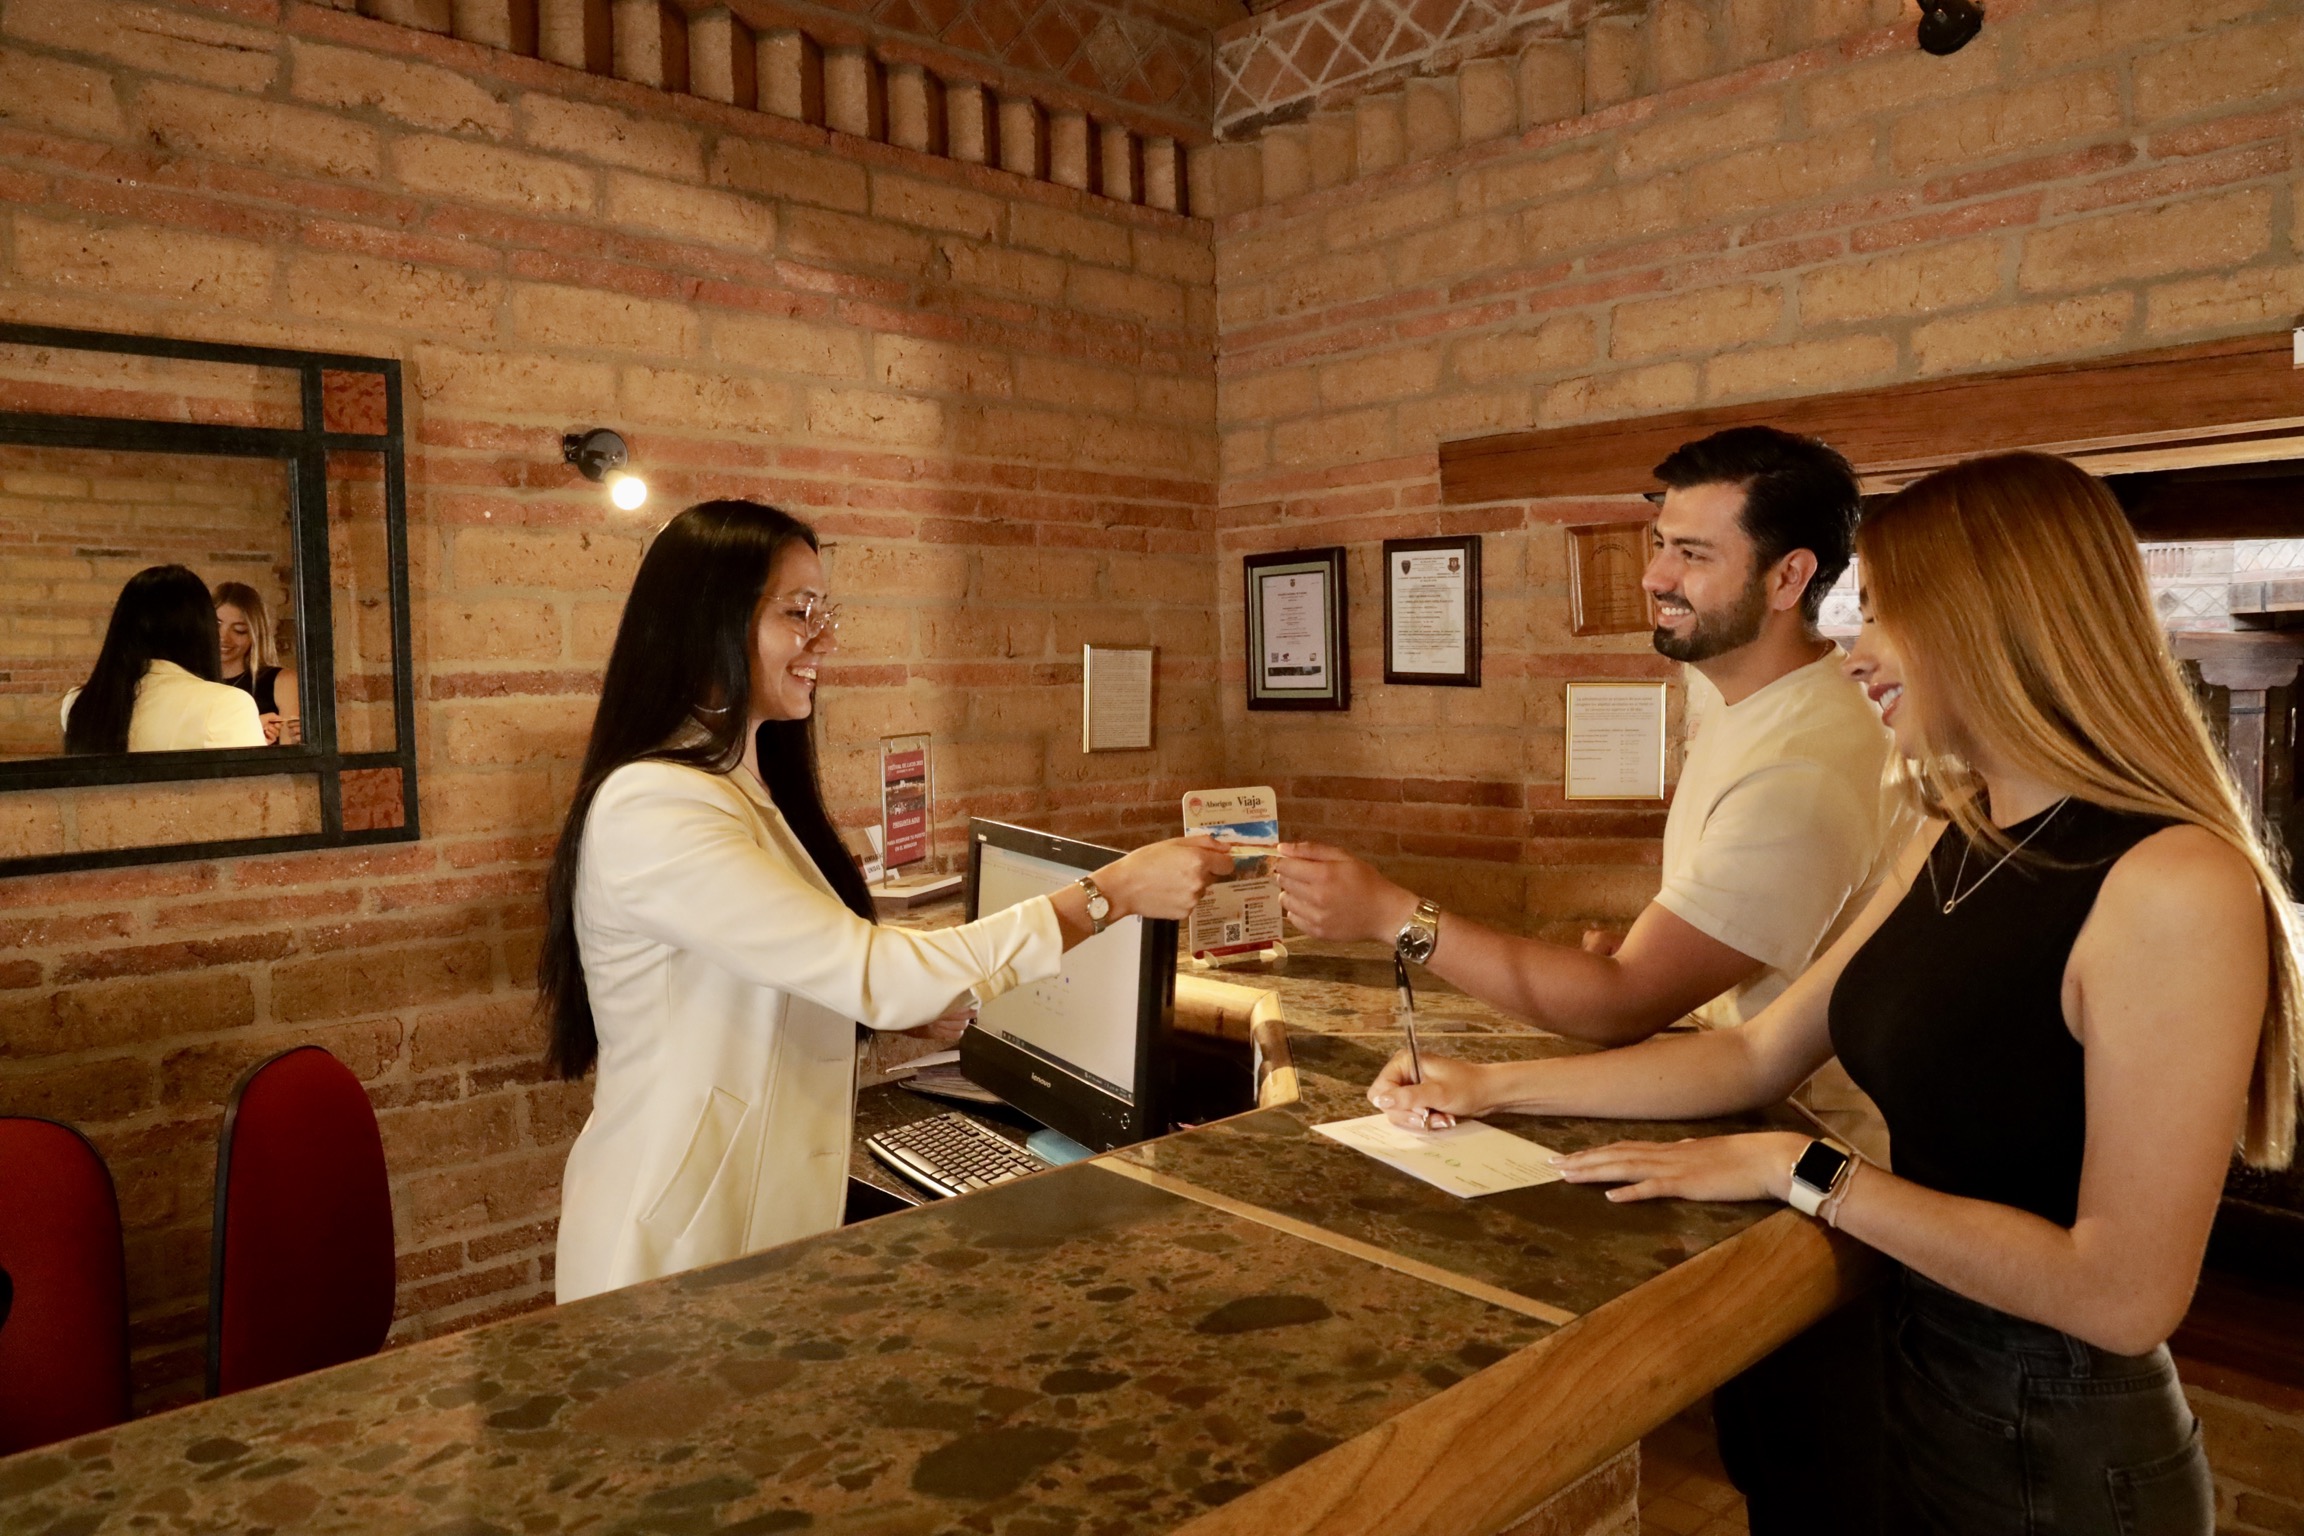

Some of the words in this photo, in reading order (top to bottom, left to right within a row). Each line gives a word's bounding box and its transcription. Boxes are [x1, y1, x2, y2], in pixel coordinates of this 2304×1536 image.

[1206, 800, 1233, 808] Aborigen
[1237, 795, 1261, 809] Viaja
[1031, 1072, 1051, 1088] lenovo
